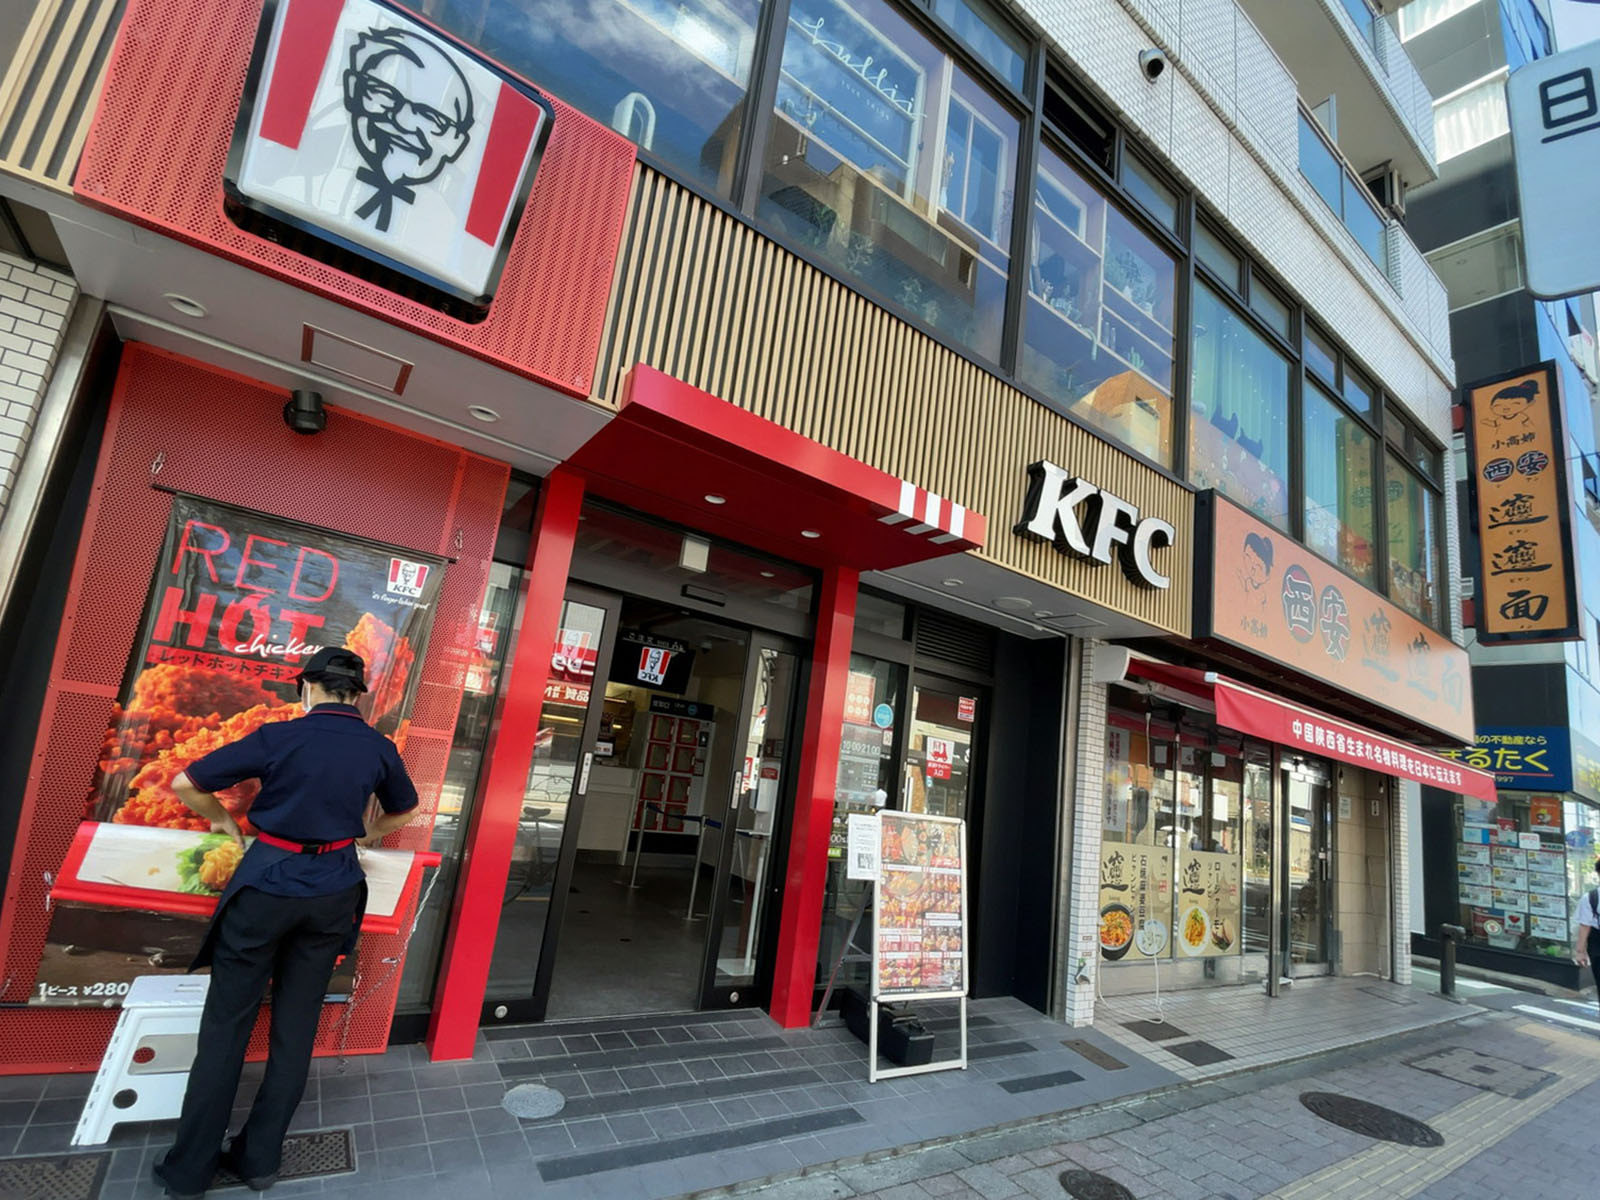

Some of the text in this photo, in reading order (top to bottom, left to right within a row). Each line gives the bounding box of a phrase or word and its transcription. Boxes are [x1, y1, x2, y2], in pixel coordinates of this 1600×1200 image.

[1028, 459, 1175, 589] KFC
[171, 519, 339, 603] RED
[393, 584, 417, 596] KFC
[152, 586, 326, 663] HOT
[1496, 775, 1514, 783] 997
[38, 983, 130, 997] 1ピース ¥280
